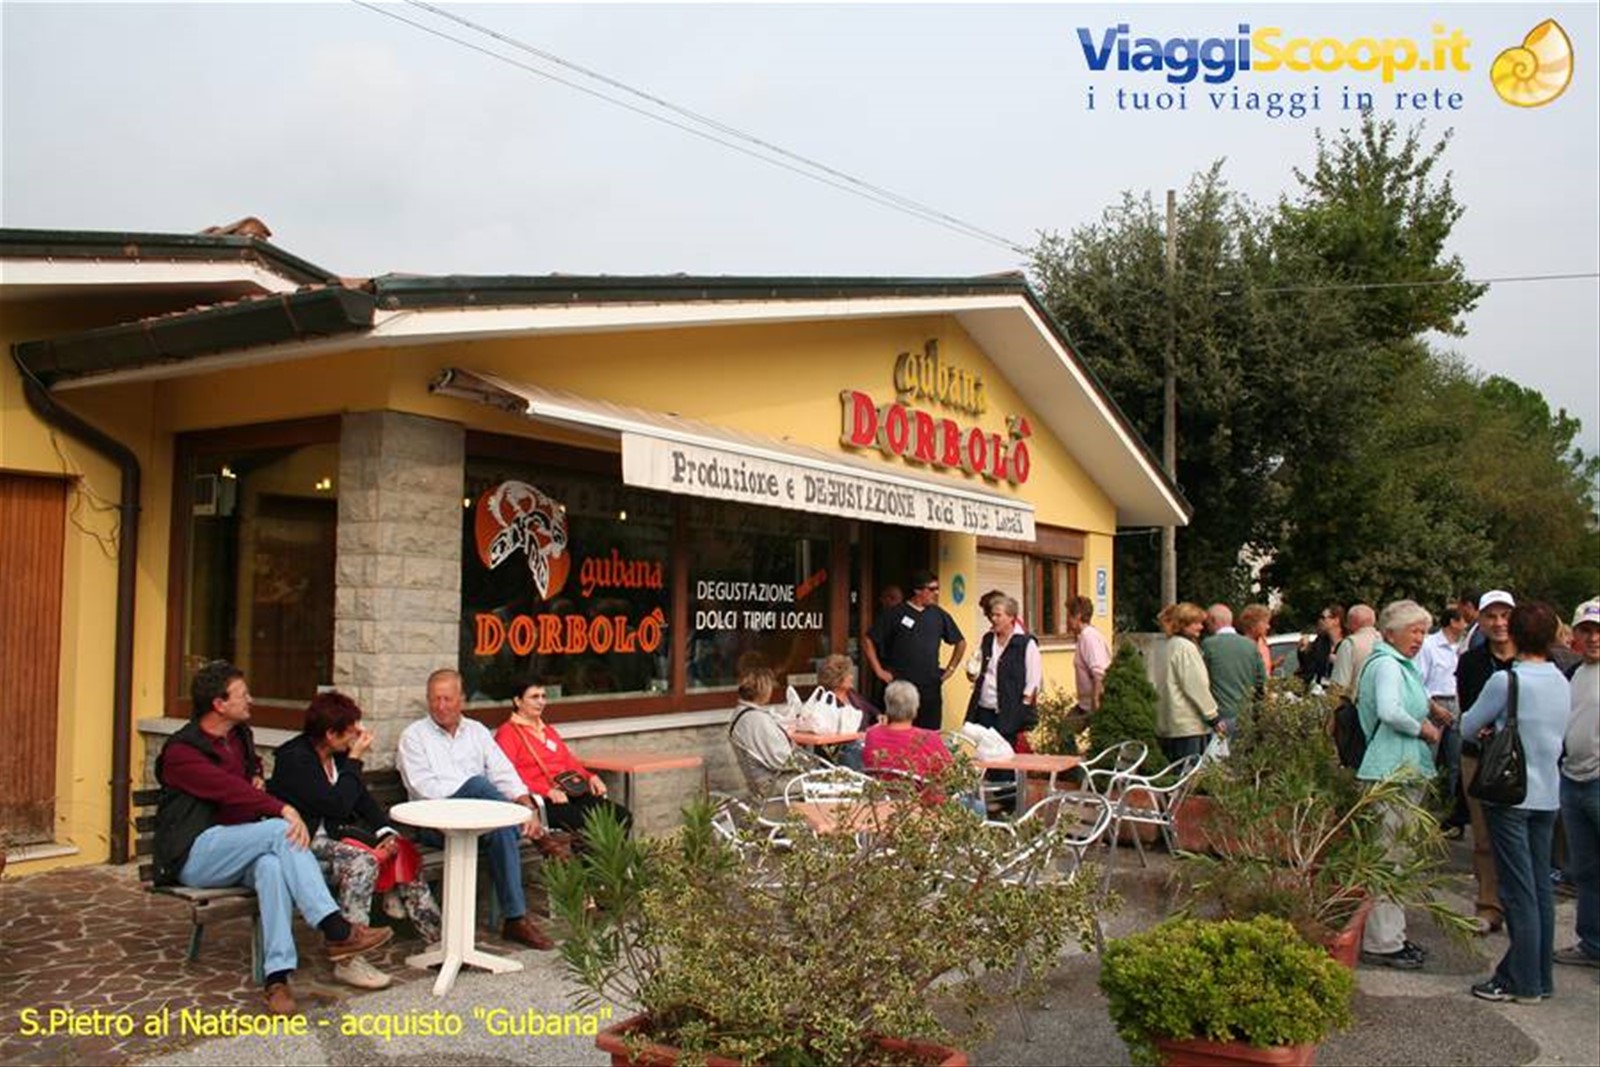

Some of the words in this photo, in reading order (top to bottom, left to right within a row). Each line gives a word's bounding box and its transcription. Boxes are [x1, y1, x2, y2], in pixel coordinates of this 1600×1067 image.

[579, 548, 663, 597] gubana
[697, 580, 795, 602] DEGUSTAZIONE
[696, 610, 737, 630] DOLCI
[743, 611, 777, 631] TIPICI
[781, 611, 823, 630] LOCALI
